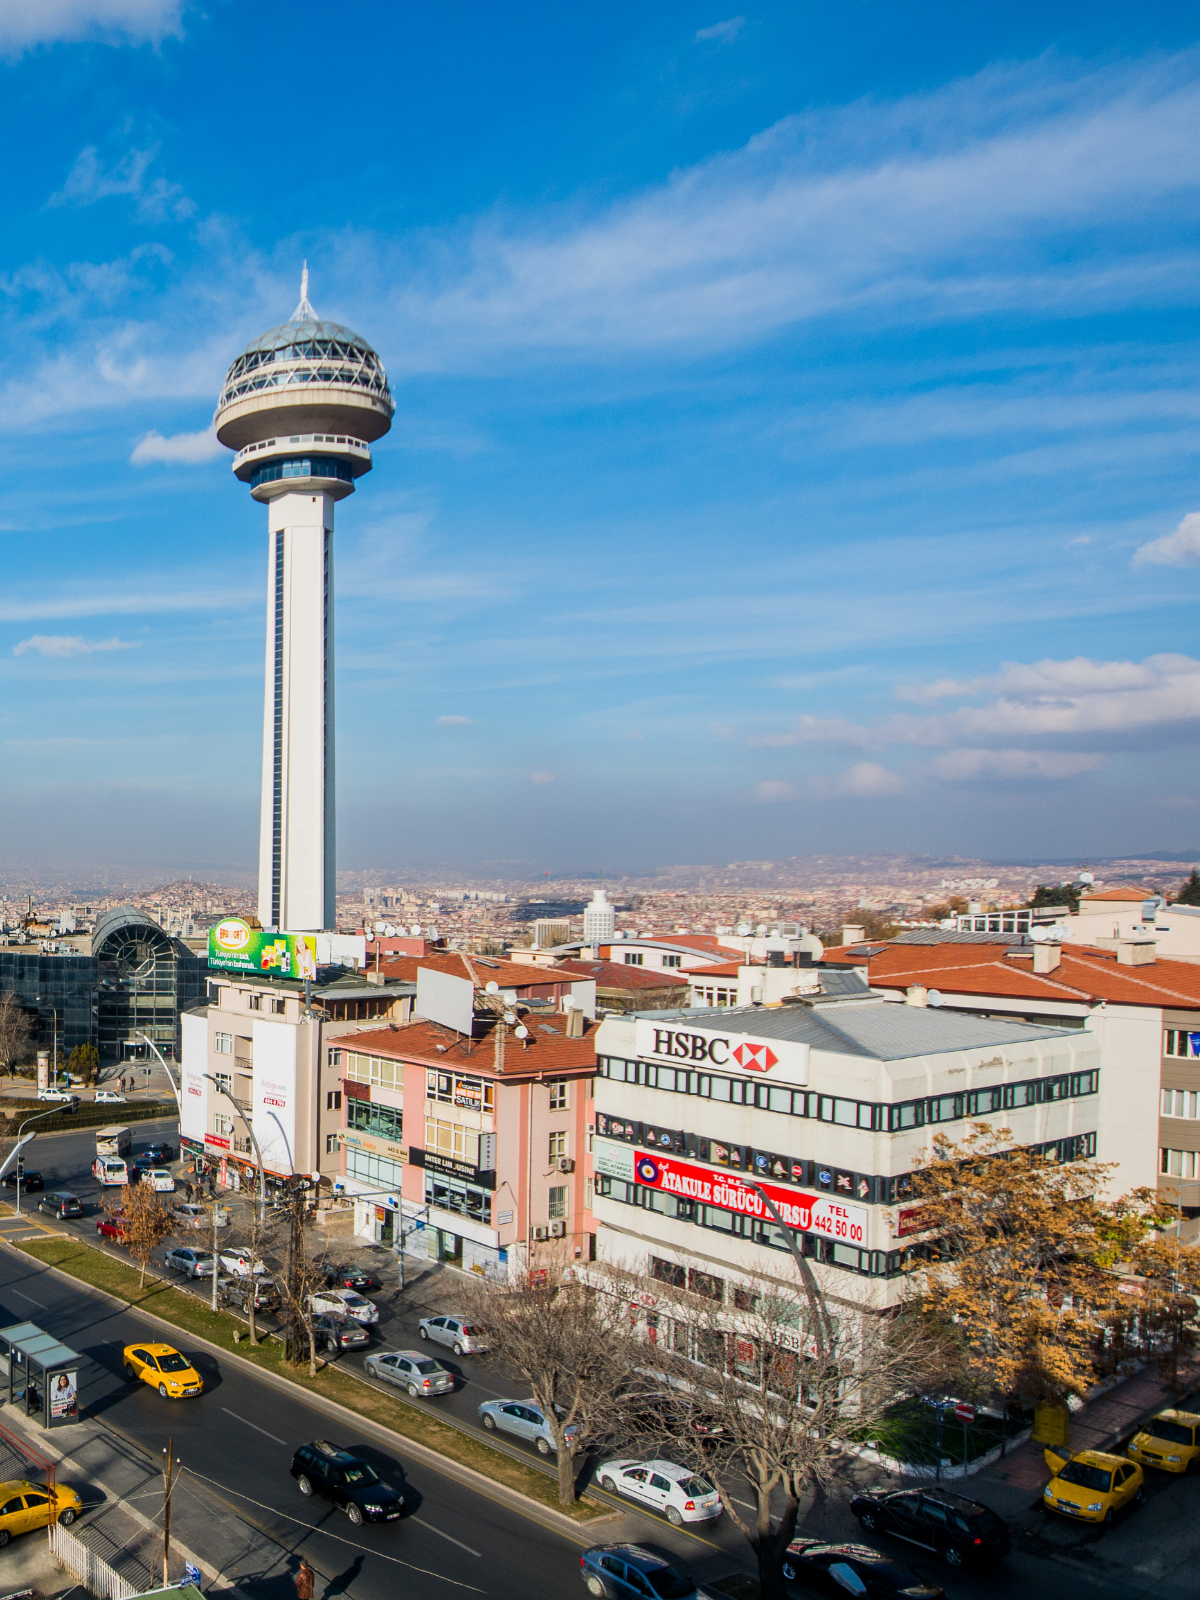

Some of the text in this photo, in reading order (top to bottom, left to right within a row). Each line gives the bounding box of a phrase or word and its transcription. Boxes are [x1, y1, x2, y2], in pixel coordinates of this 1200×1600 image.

[653, 1029, 730, 1065] HSBC
[456, 1095, 481, 1107] SATILIK
[424, 1153, 441, 1165] INTER
[712, 1173, 727, 1185] T.C.
[661, 1175, 711, 1200] ATAKULE
[713, 1184, 762, 1215] SÜRÜCÜ
[828, 1204, 849, 1218] TEL
[814, 1214, 863, 1242] 442 50 00
